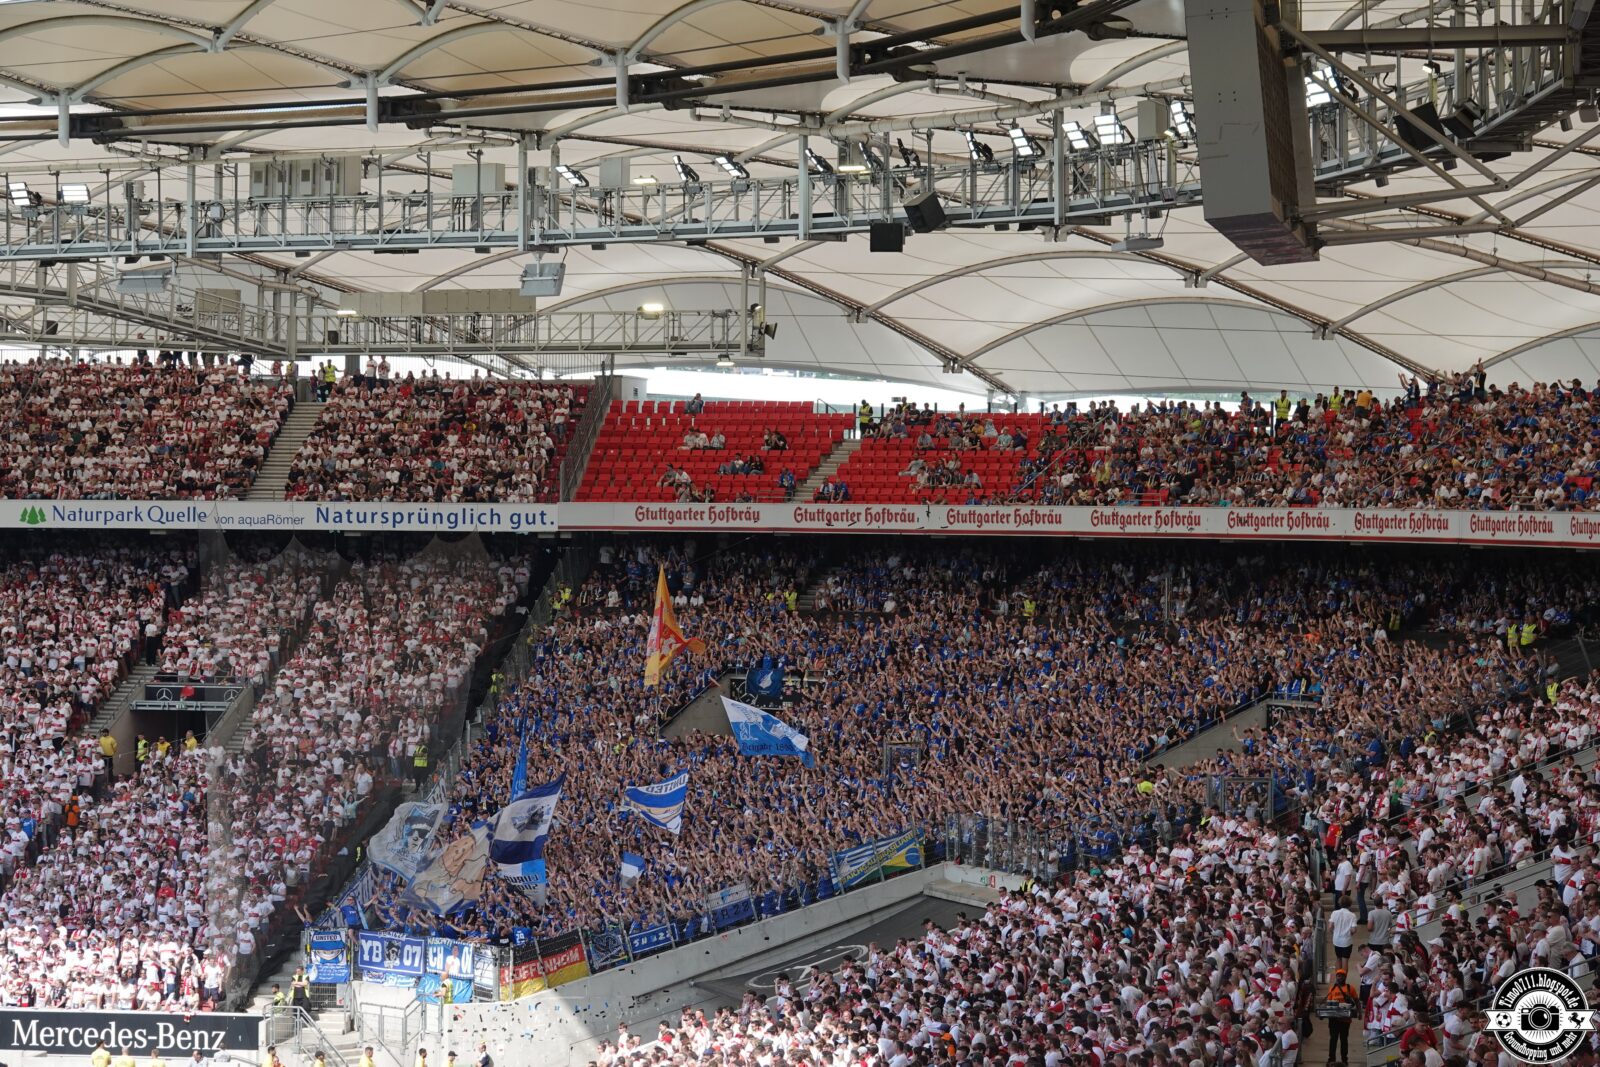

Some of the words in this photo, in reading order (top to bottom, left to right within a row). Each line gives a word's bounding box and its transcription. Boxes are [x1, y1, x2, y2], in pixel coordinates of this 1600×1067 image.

[52, 505, 143, 528] Naturpark
[147, 505, 207, 524] Quelle
[213, 515, 234, 525] von
[238, 513, 304, 528] aquaRömer
[316, 506, 502, 529] Natursprünglich
[509, 509, 555, 530] gut.
[635, 505, 705, 525] Stuttgarter
[708, 505, 760, 524] Hofbräu
[793, 506, 862, 526] Stuttgarter
[864, 507, 916, 526] Hofbräu
[946, 507, 1011, 529] Stuttgarter
[1013, 508, 1062, 528] Hofbräu
[1090, 508, 1152, 530] Stuttgarter
[1155, 509, 1201, 529] Hofbräu
[1227, 510, 1285, 532] Stuttgarter
[1286, 511, 1330, 531] Hofbräu
[1354, 511, 1408, 534] Stuttgarter
[1409, 511, 1449, 533] Hofbräu
[1470, 513, 1516, 536] Stuttgarter
[1518, 514, 1553, 535] Hofbräu
[360, 939, 383, 963] YB
[402, 944, 422, 968] 07
[11, 1019, 226, 1050] Mercedes-Benz
